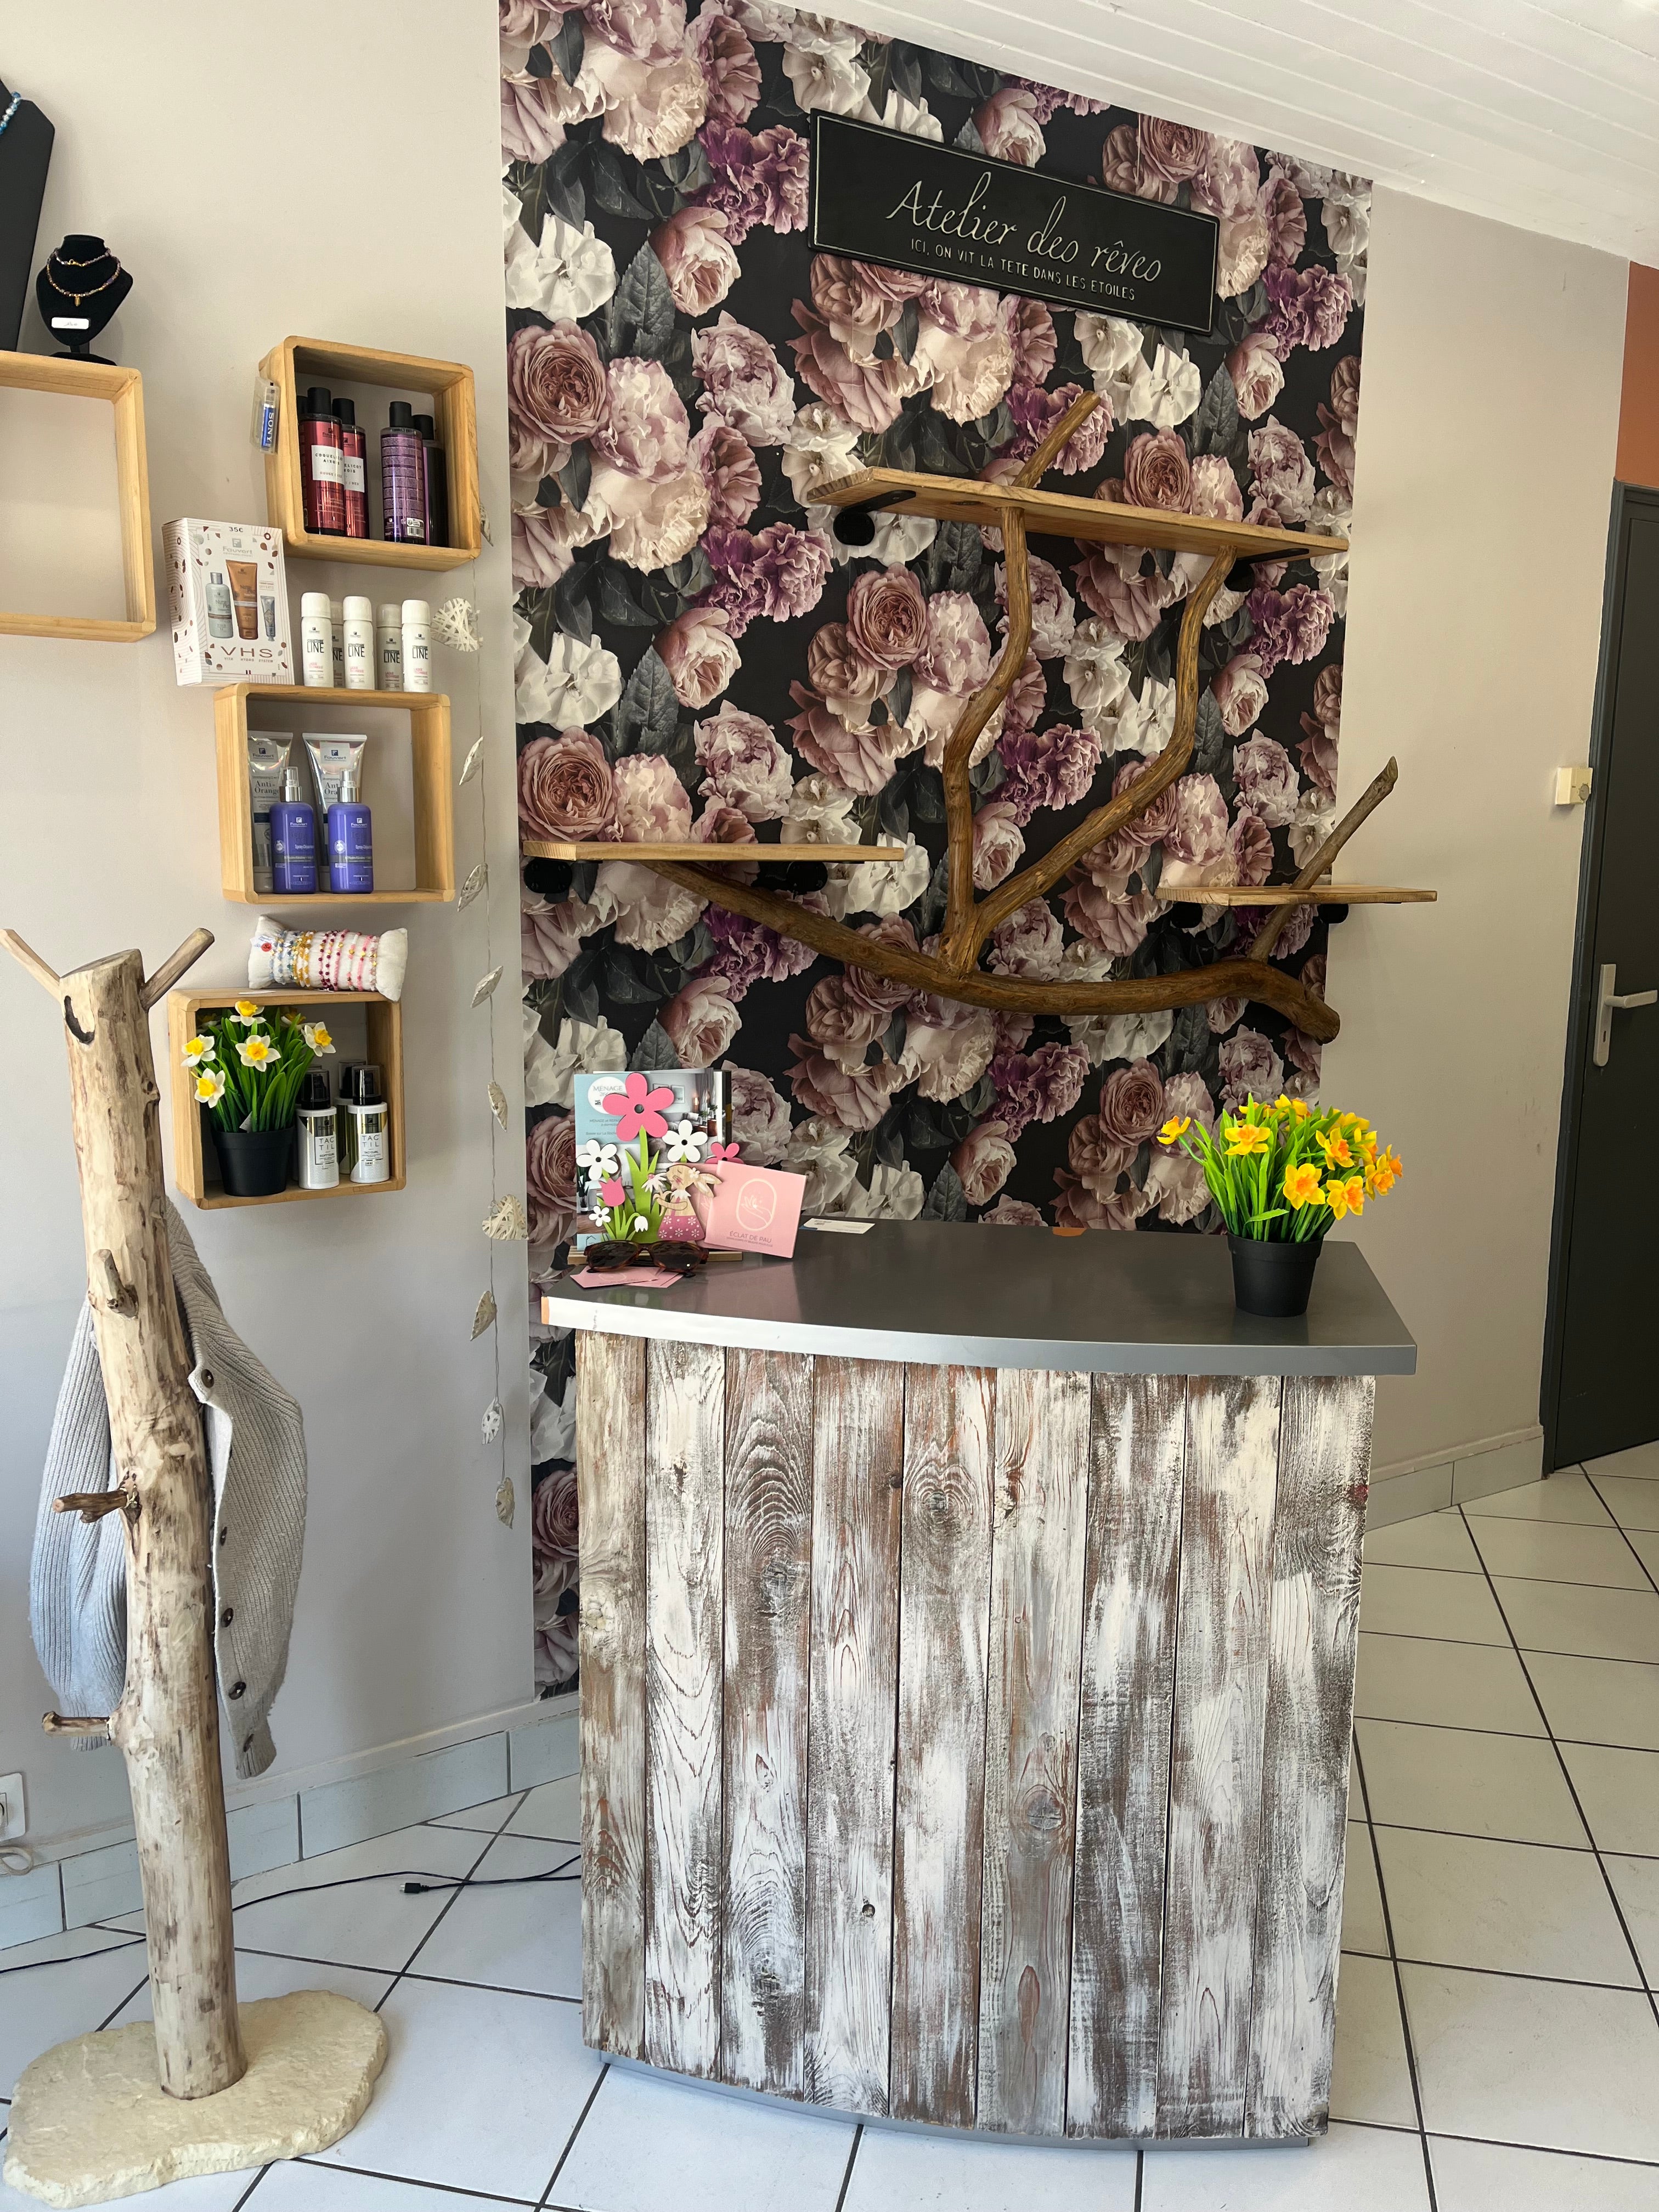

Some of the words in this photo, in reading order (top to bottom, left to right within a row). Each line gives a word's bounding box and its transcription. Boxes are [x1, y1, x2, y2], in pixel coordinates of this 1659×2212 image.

[885, 171, 1018, 245] Atelier
[1028, 196, 1079, 263] des
[1091, 240, 1161, 281] rêves
[911, 238, 929, 256] ICI,
[935, 244, 951, 258] ON
[957, 249, 975, 264] VIT
[981, 255, 994, 268] LA
[1001, 258, 1029, 277] TETE
[1034, 267, 1062, 285] DANS
[1066, 274, 1086, 290] LES
[1091, 280, 1135, 300] ETOILES
[223, 546, 252, 555] Fauvert
[221, 646, 273, 658] VHS
[307, 642, 325, 653] LINE
[348, 646, 365, 658] LINE
[332, 650, 343, 662] NE
[383, 652, 400, 664] LINE
[412, 648, 429, 660] LINE
[729, 1231, 749, 1239] ÉCLAT
